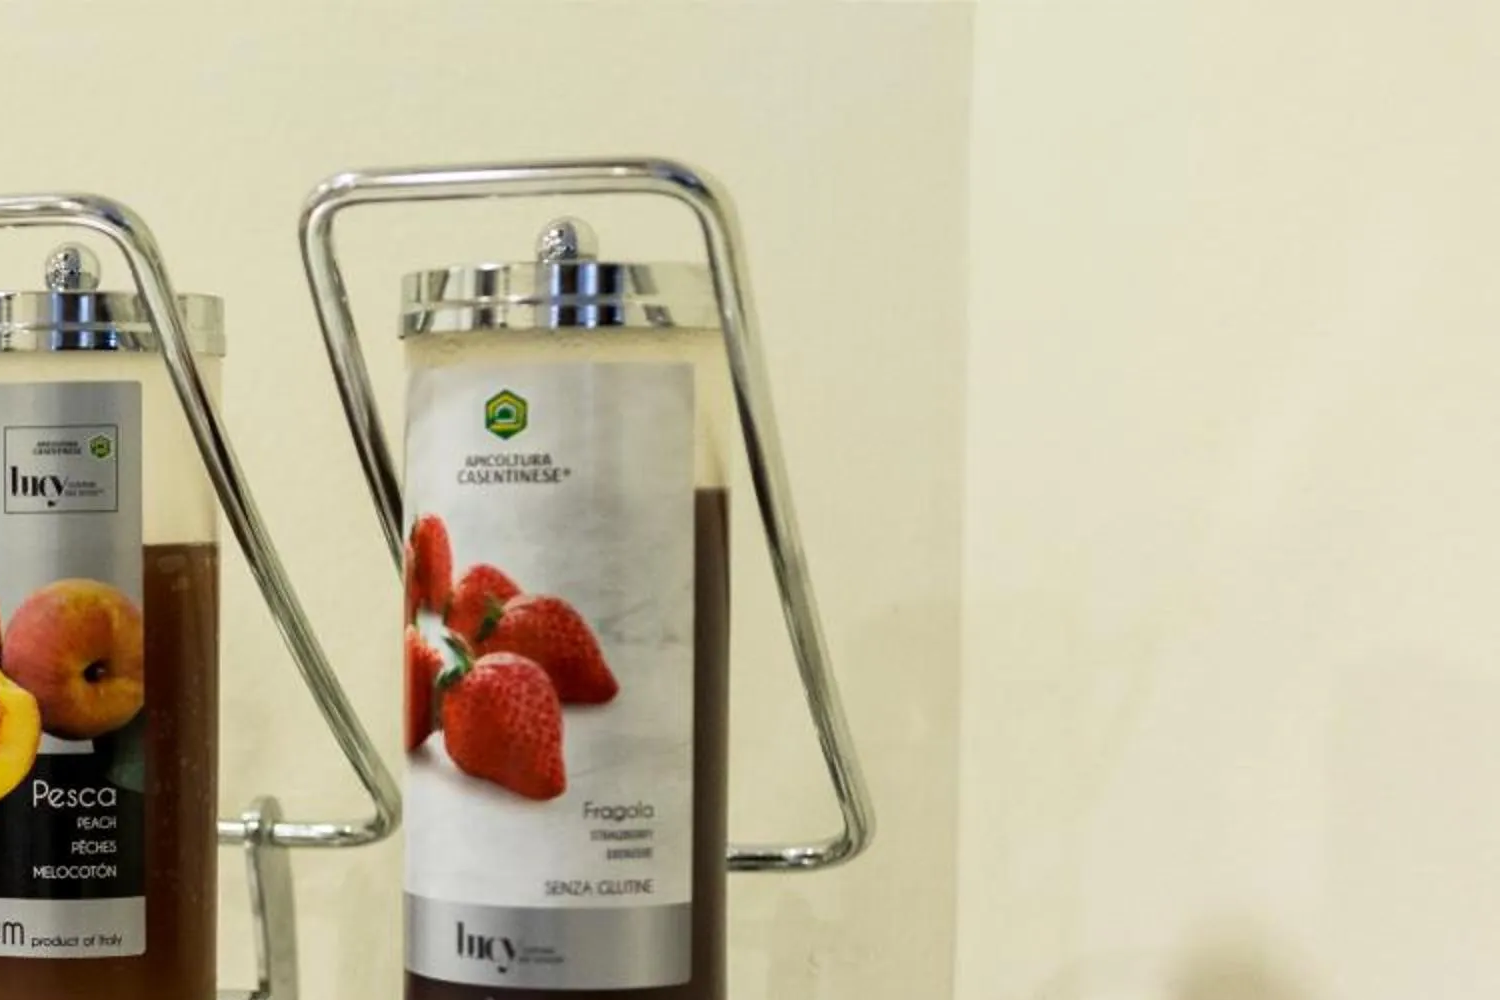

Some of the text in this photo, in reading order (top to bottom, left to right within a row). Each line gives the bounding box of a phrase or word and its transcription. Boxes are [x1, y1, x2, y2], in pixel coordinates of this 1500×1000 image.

[32, 779, 117, 808] Pesca
[583, 800, 655, 822] Fragola
[77, 815, 117, 829] PEACH
[32, 863, 117, 880] MELOCOTÓN
[544, 879, 655, 896] SENZA GLUTINE
[31, 933, 123, 948] product of Italy
